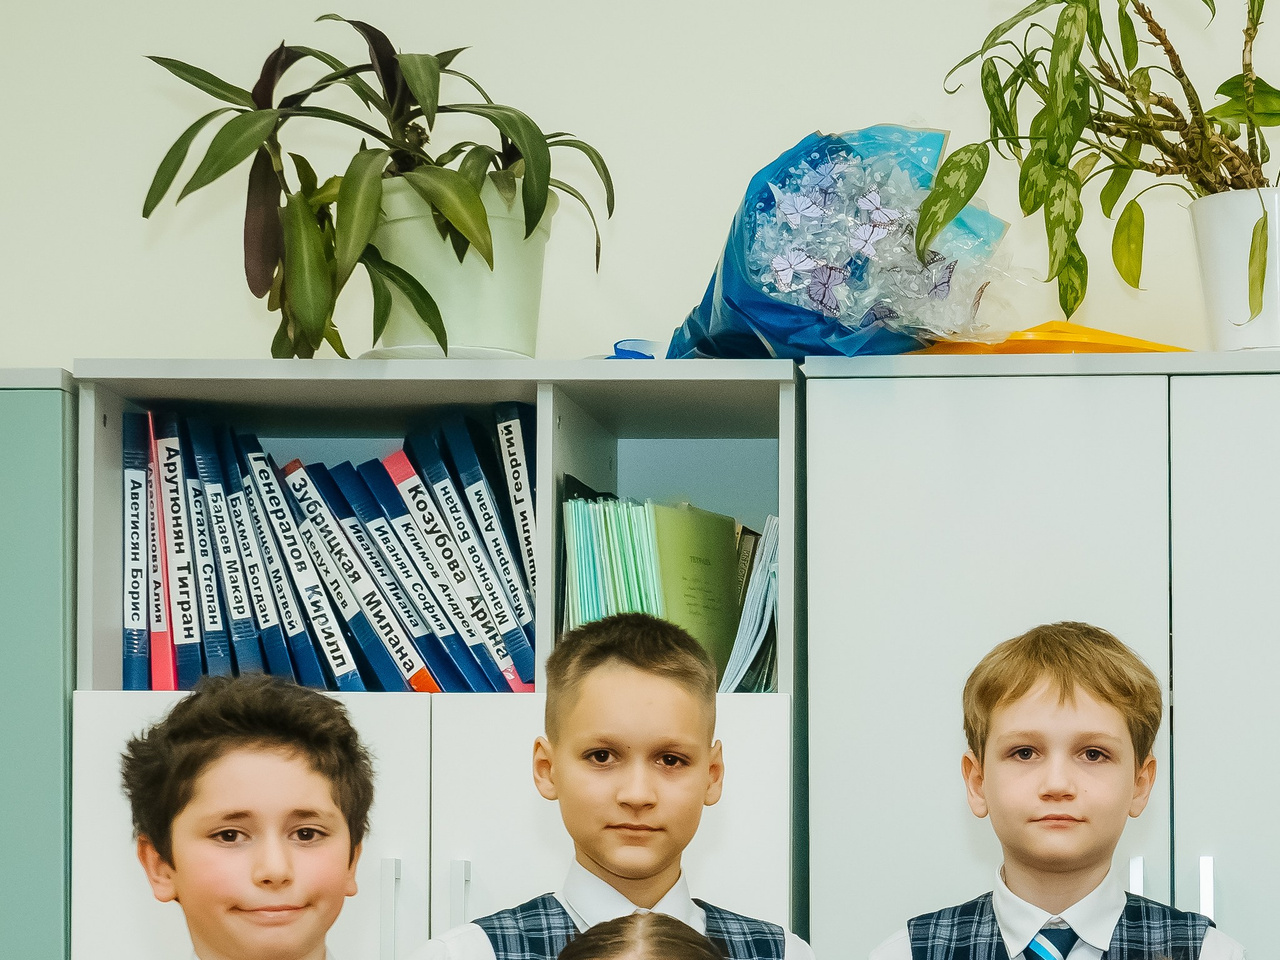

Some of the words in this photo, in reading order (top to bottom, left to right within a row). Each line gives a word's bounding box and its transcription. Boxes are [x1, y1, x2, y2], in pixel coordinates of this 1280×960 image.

[440, 485, 471, 544] Богдан
[473, 489, 496, 533] Арам
[501, 424, 525, 505] Георгий
[130, 479, 143, 562] Аветисян
[163, 446, 185, 554] Арутюнян
[176, 561, 195, 639] Тигран
[191, 486, 209, 558] Астахов
[202, 563, 218, 625] Степан
[210, 492, 232, 554] Бадаев
[225, 559, 246, 616] Макар
[229, 496, 253, 559] Бахмат
[247, 563, 271, 624] Богдан
[243, 484, 274, 565] Вотинцев
[271, 568, 299, 631] Матвей
[252, 456, 308, 573] Генералов
[304, 584, 347, 668] Кирилл
[301, 528, 331, 577] Дедух
[329, 578, 349, 610] Лев
[407, 483, 467, 585] Козубова
[465, 594, 510, 661] Арина
[519, 510, 536, 598] ишвили
[128, 568, 143, 622] Борис
[153, 579, 162, 623] Алия
[291, 477, 362, 585] Зубрицкая
[362, 590, 415, 673] Милана
[348, 523, 387, 577] Иванян
[385, 581, 420, 628] Лиана
[373, 525, 413, 579] Иванян
[411, 582, 447, 631] София
[400, 522, 440, 579] Климов
[437, 583, 477, 638] Андрей
[467, 545, 509, 626] Маненков
[491, 537, 526, 619] Маргарян
